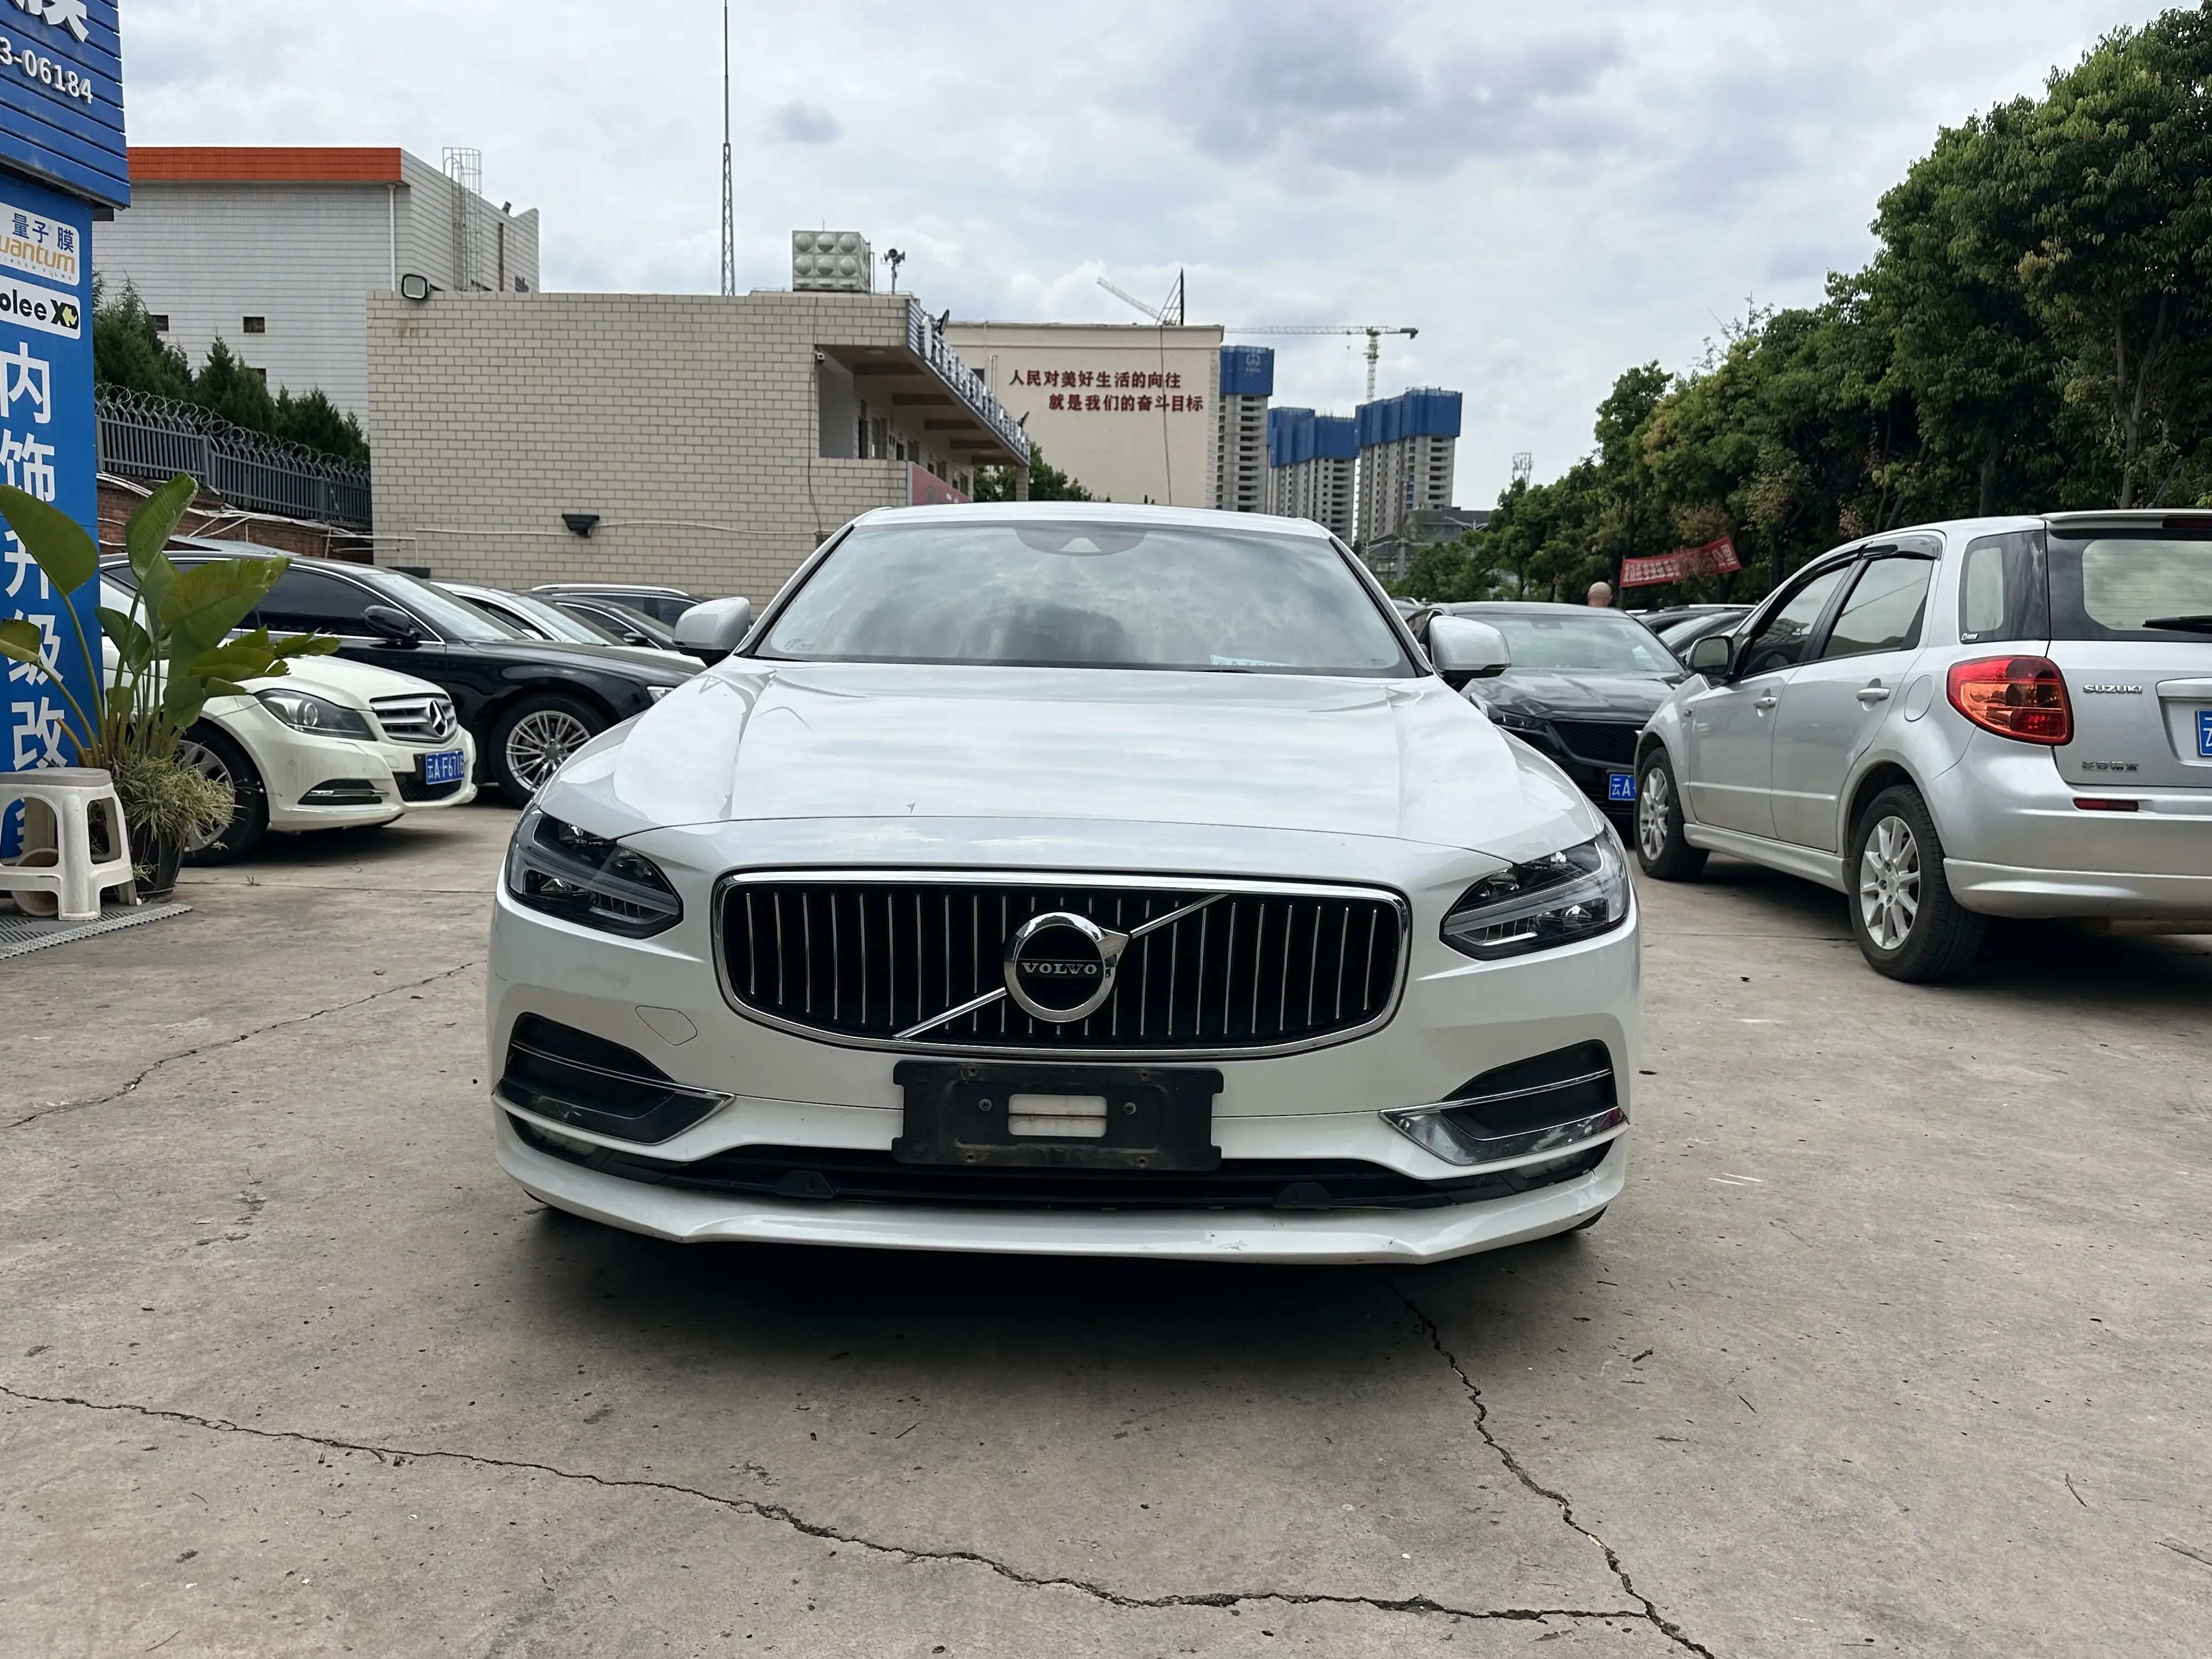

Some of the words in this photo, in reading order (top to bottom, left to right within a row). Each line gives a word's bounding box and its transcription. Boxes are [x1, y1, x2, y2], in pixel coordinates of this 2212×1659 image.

[12, 212, 74, 253] 量子膜
[0, 255, 35, 269] INDOW
[1009, 369, 1181, 389] 人民对美好生活的向往
[1048, 393, 1203, 412] 就是我们的奋斗目标
[2083, 684, 2142, 694] SUZUKI
[1022, 962, 1097, 974] VOLVO
